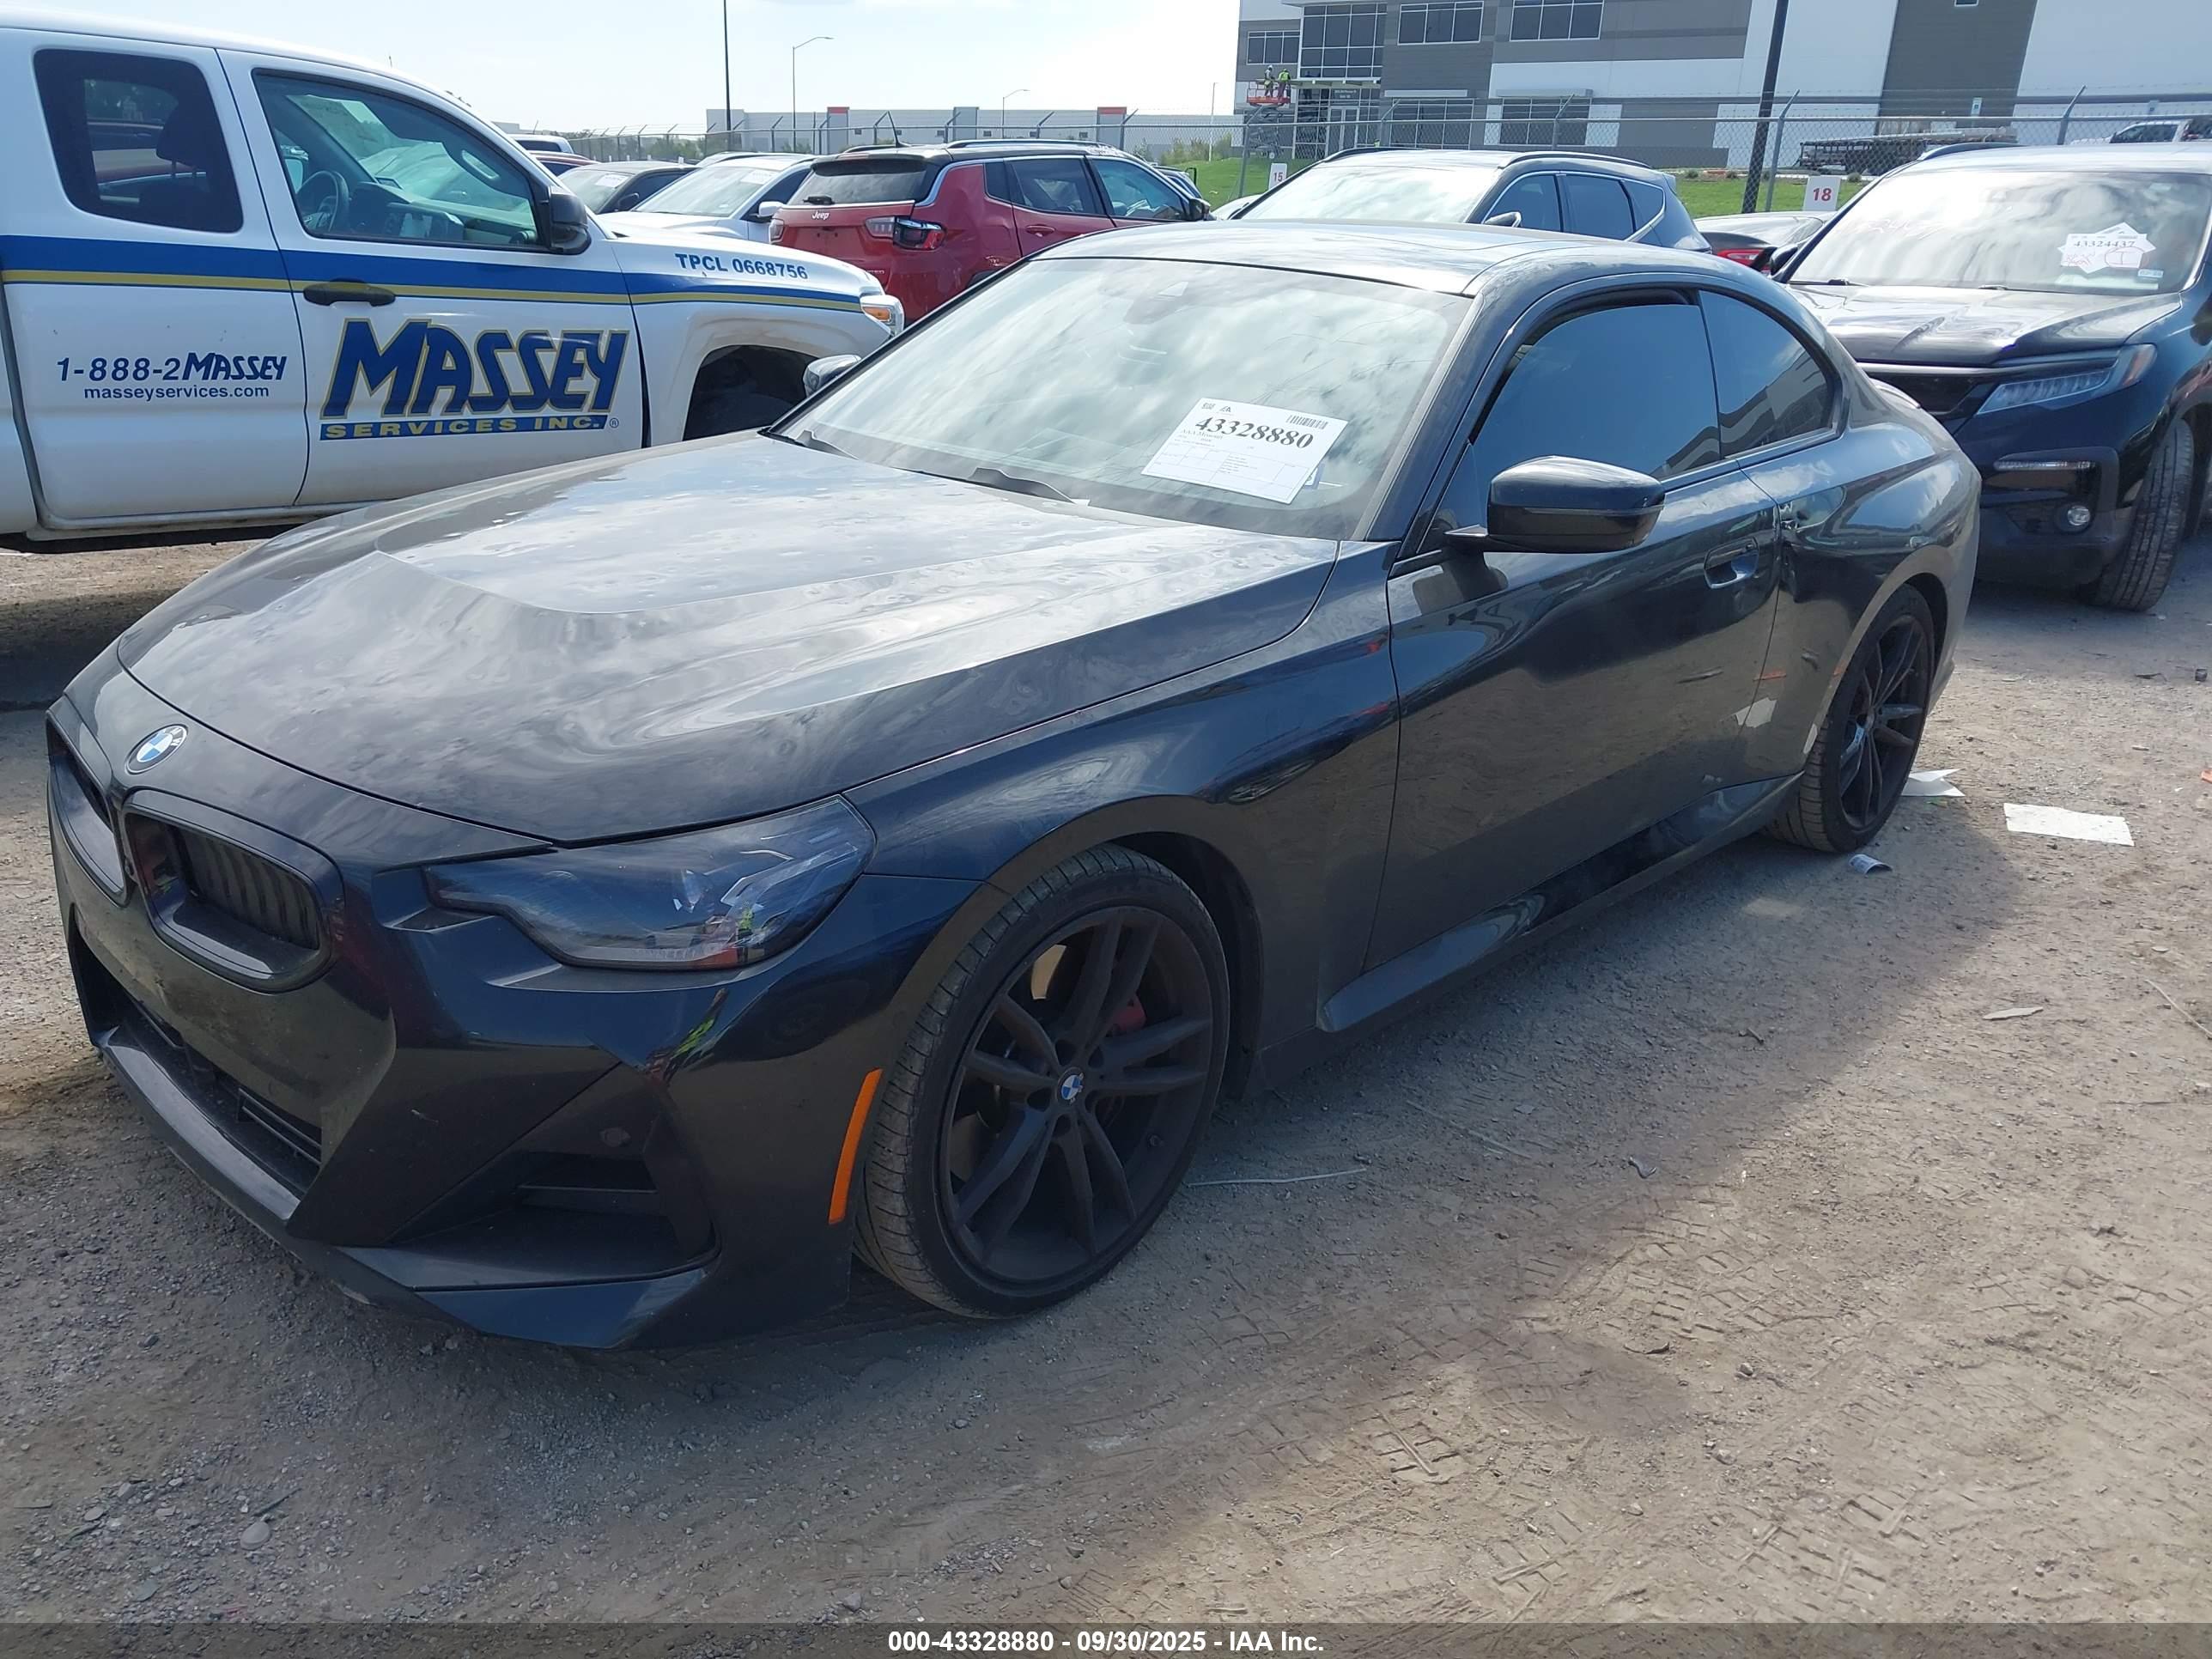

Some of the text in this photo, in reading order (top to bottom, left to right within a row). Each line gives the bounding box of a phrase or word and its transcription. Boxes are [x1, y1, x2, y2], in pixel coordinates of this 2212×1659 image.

[1273, 172, 1283, 182] 15
[1813, 187, 1832, 202] 18
[811, 210, 830, 221] Jeep
[675, 253, 808, 279] TPCL 0668756
[319, 319, 630, 419] MASSEY
[84, 385, 269, 401] masseyservices.com
[325, 418, 517, 440] SERVICES
[535, 416, 600, 430] INC.
[1195, 416, 1314, 449] 43328880
